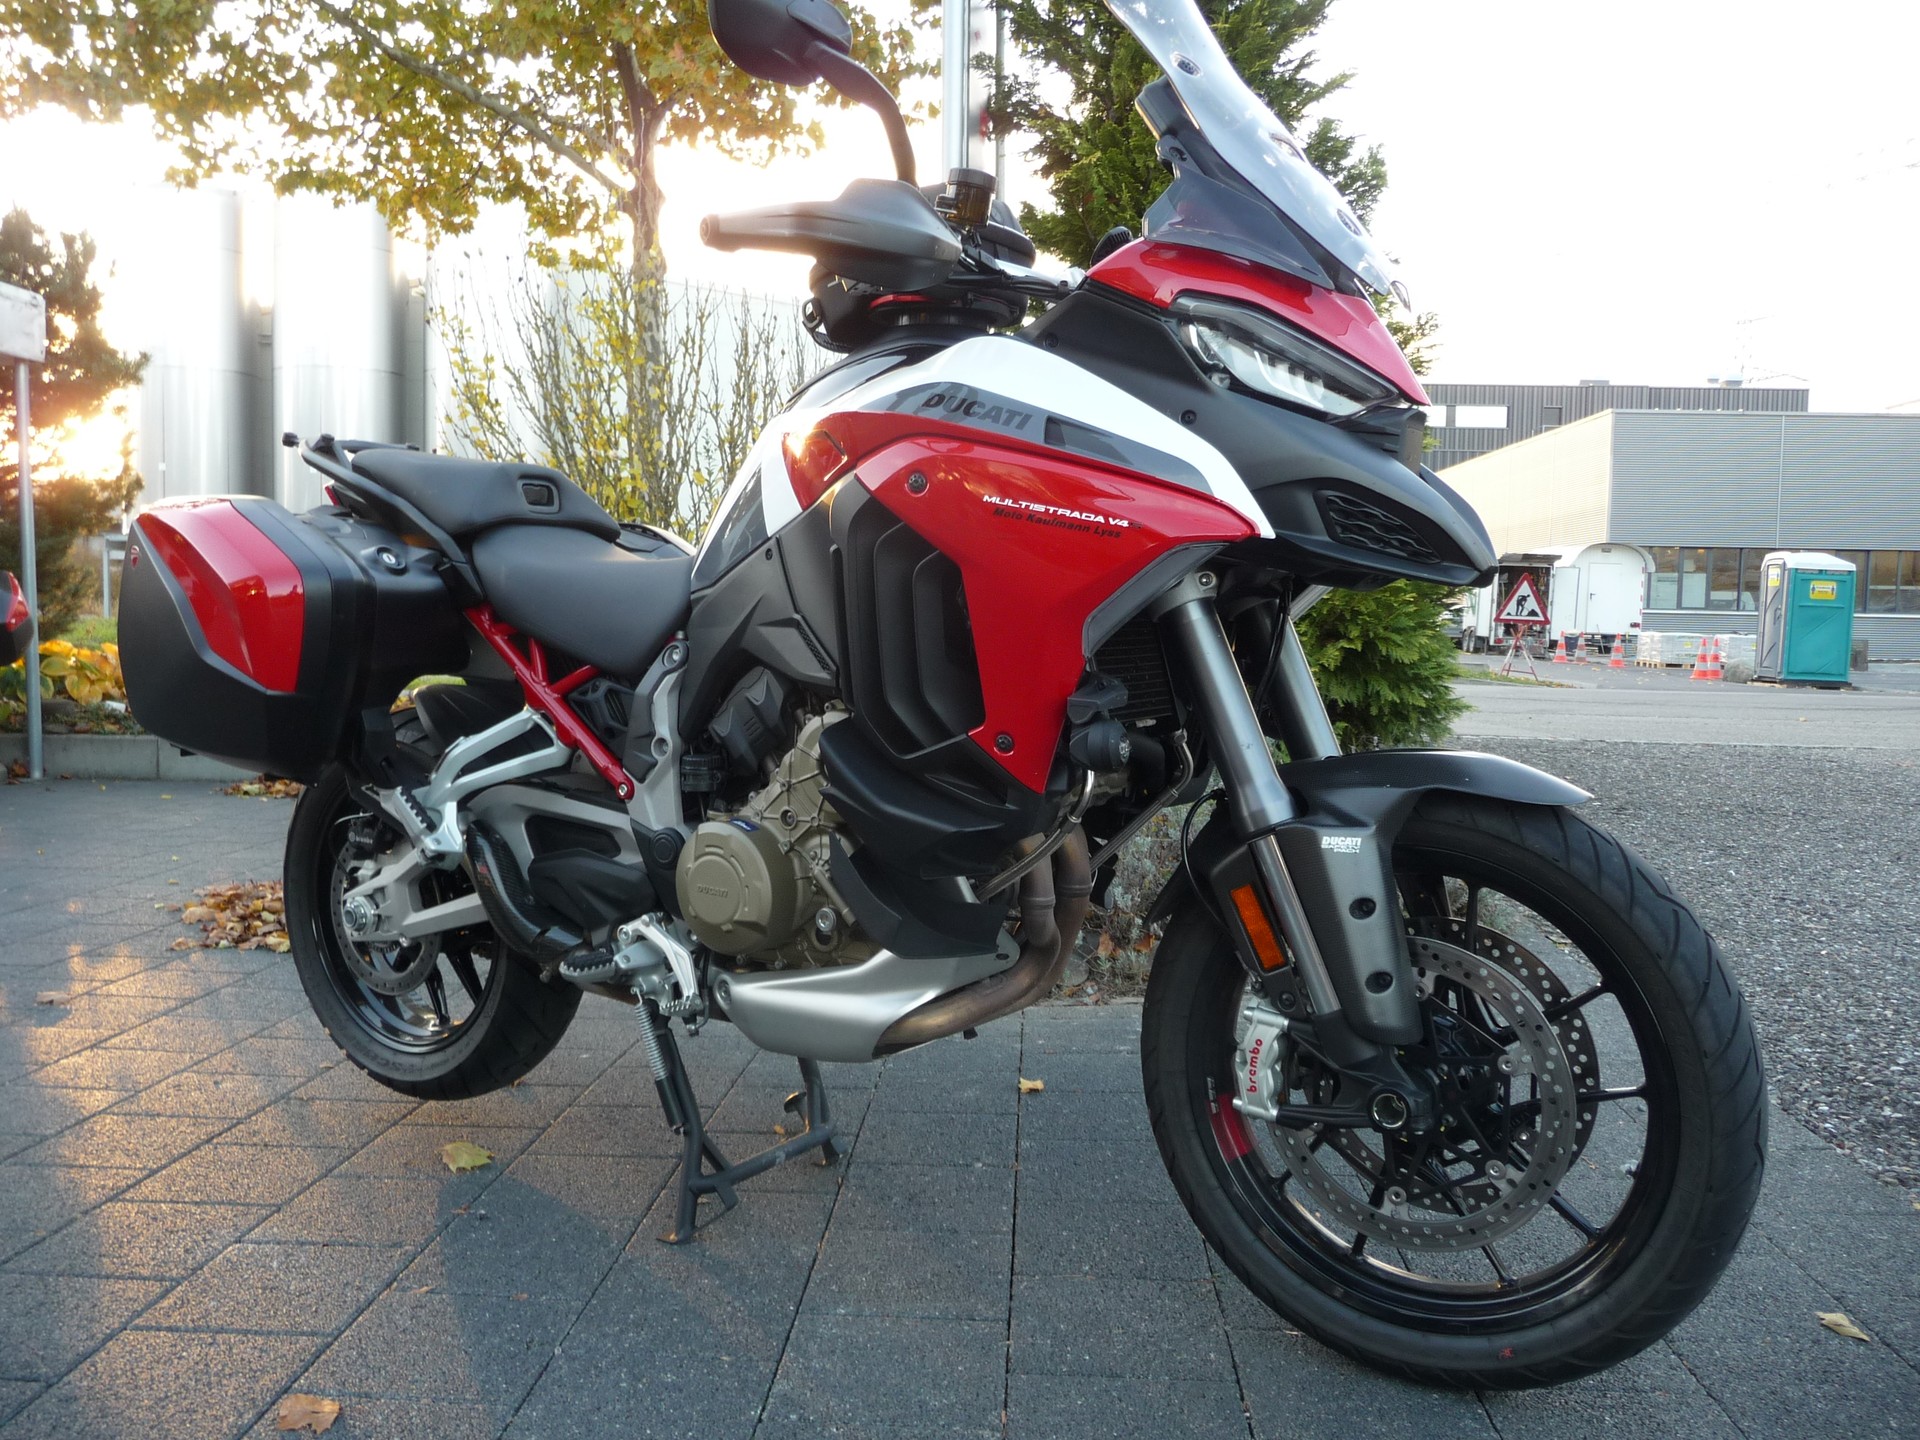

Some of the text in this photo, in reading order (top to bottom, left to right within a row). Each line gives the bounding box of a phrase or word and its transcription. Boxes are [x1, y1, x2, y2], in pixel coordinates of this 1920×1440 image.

[921, 393, 1033, 430] DUCATI
[982, 495, 1105, 524] MULTISTRADA
[993, 507, 1122, 539] Moto Kaufmann Lyss
[1321, 836, 1362, 846] DUCATI
[1246, 1038, 1263, 1092] brembo
